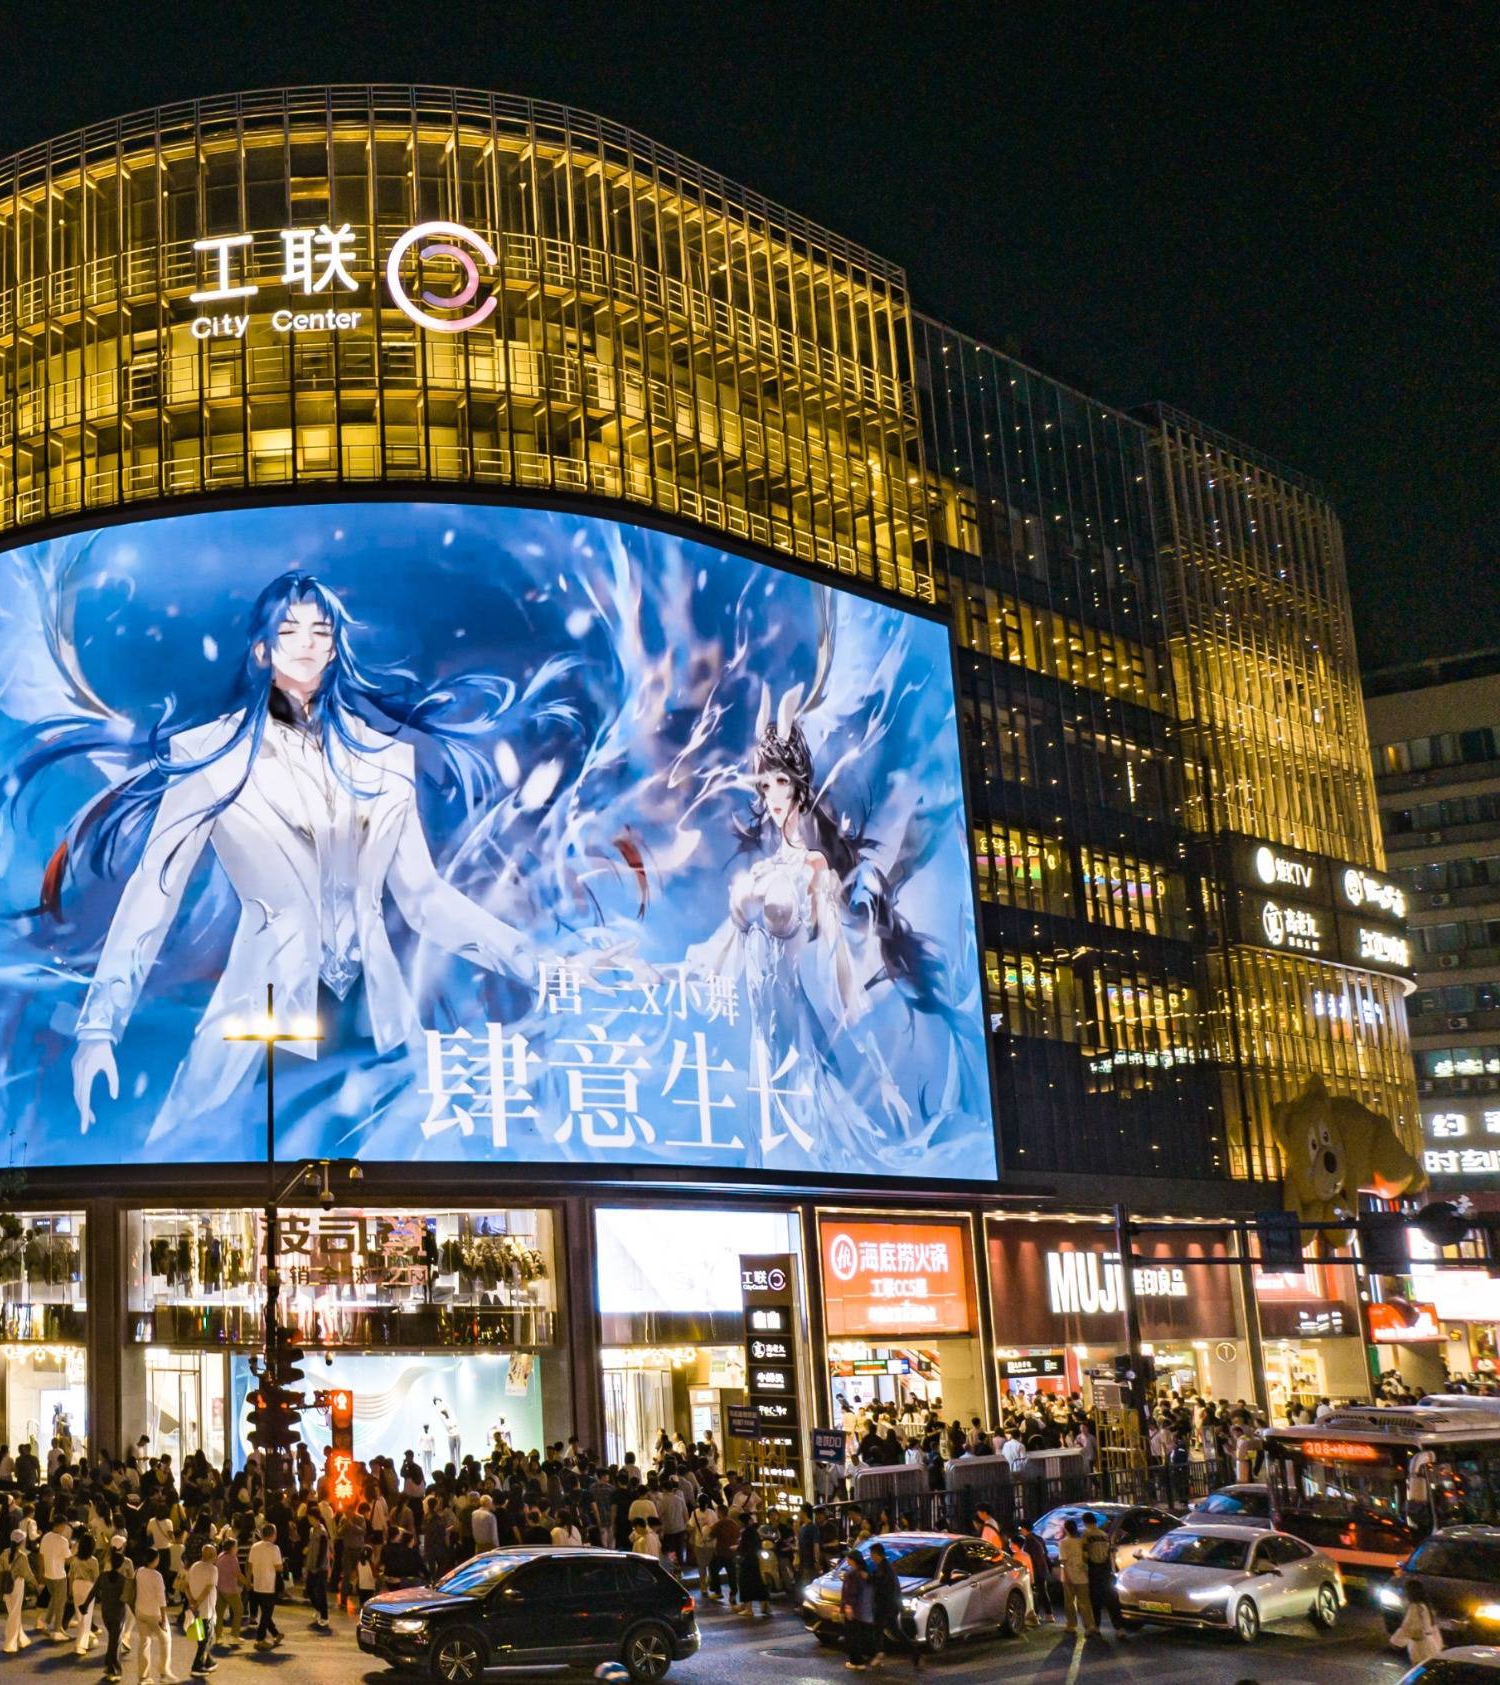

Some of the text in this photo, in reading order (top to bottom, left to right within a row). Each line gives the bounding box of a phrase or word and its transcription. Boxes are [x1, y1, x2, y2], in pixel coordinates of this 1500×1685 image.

[190, 223, 359, 302] 工联
[190, 310, 362, 339] City Center
[417, 1021, 816, 1156] 肆意生长
[742, 1270, 767, 1285] 工联
[858, 1242, 949, 1273] 海底捞火锅
[1047, 1252, 1127, 1313] MUJI
